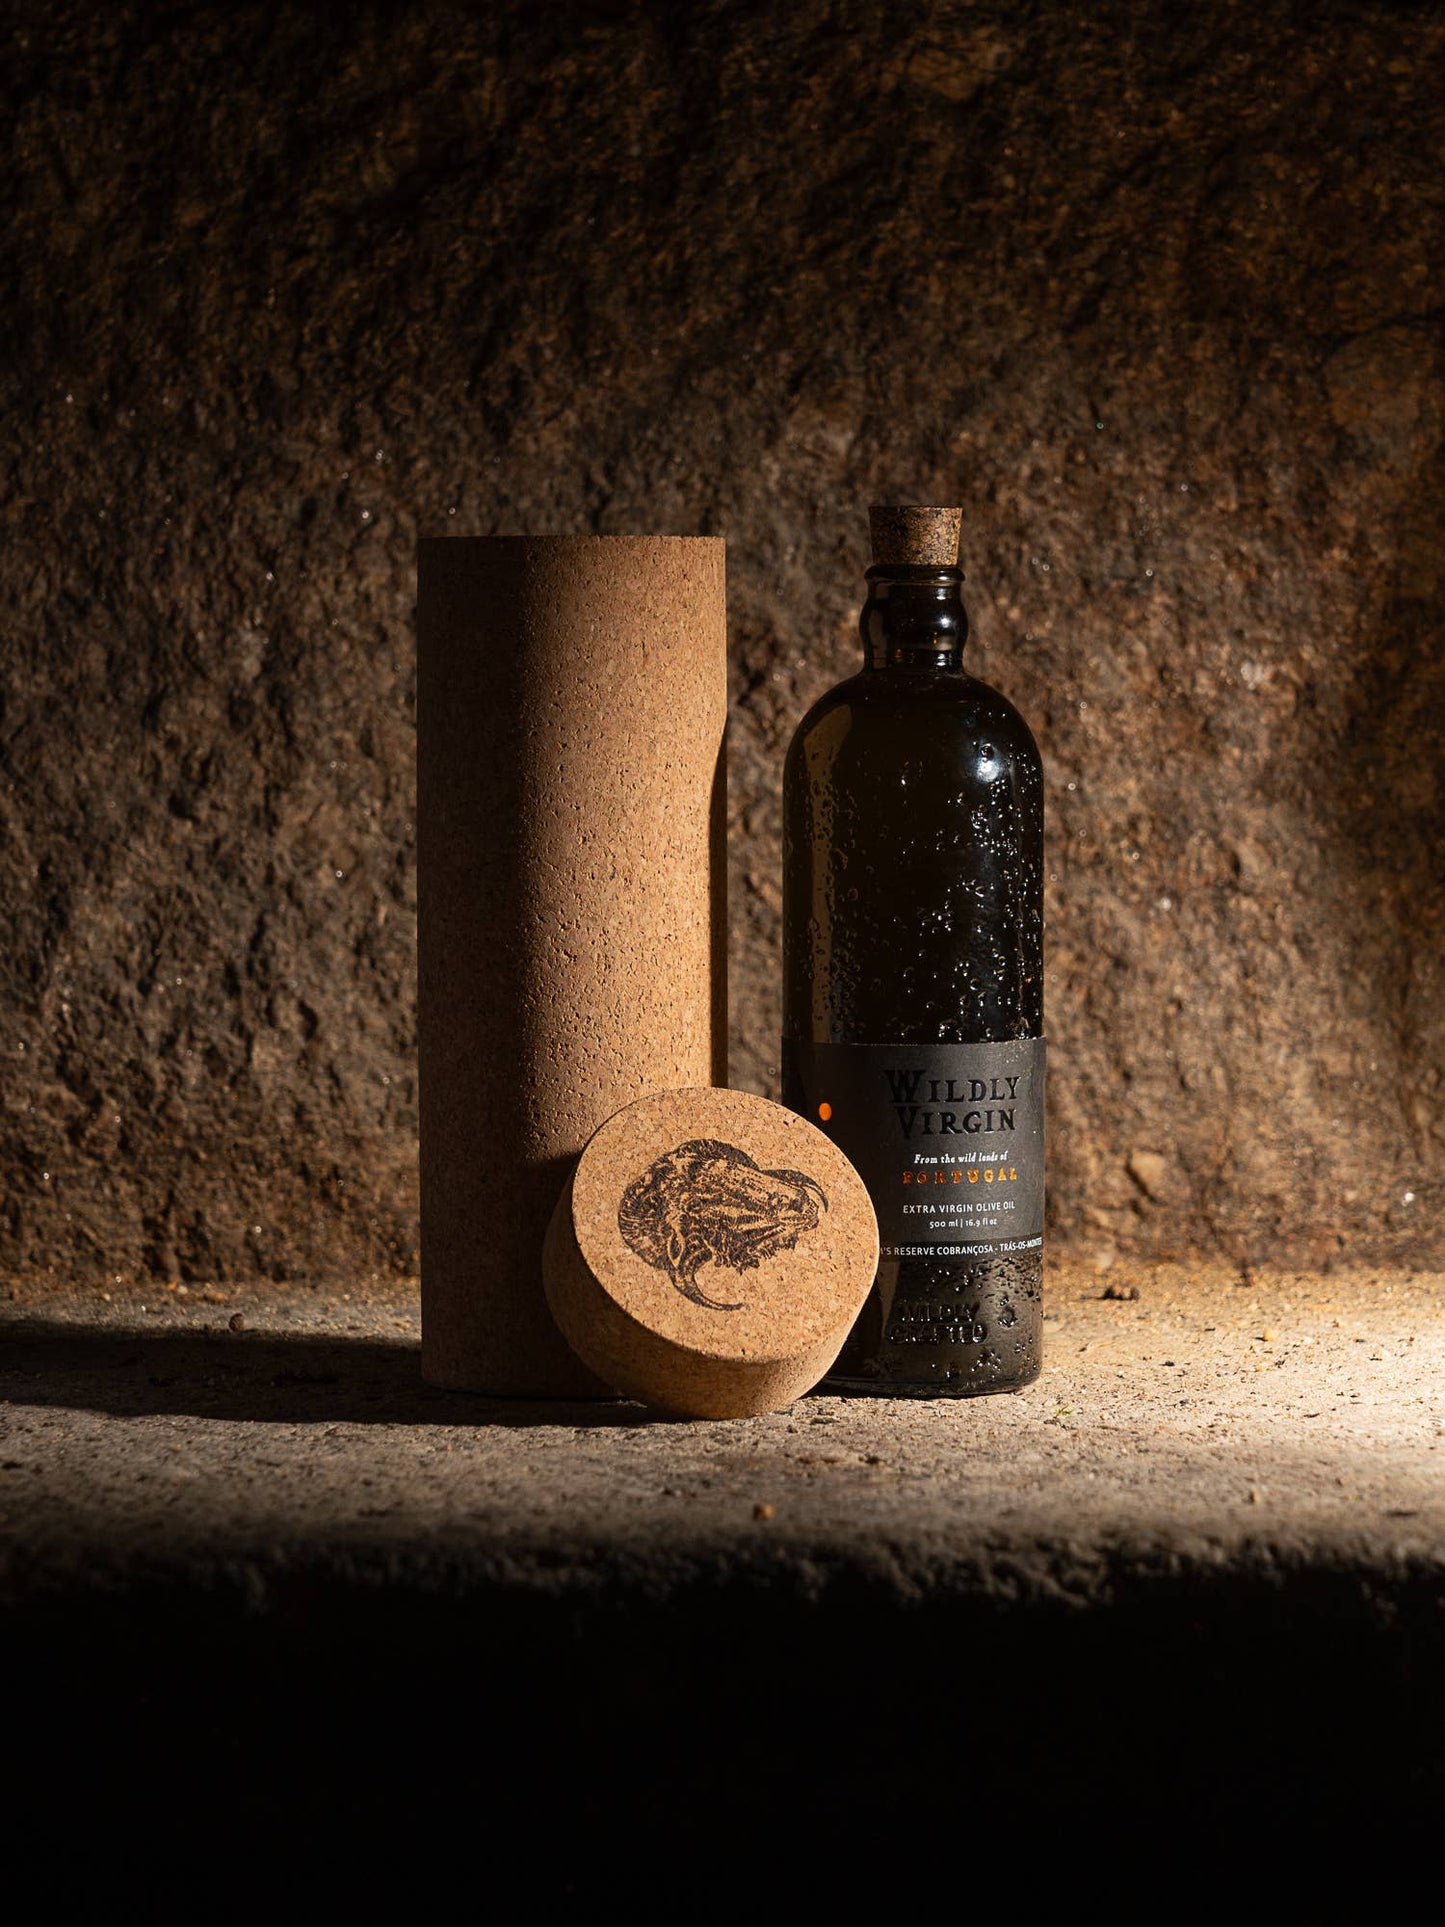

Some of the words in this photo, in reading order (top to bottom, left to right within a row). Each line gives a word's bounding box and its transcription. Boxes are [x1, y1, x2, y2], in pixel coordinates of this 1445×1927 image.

[914, 1154, 938, 1164] From
[941, 1153, 956, 1164] the
[958, 1152, 977, 1163] wild
[1000, 1150, 1009, 1161] of
[902, 1167, 1017, 1184] PORTUGAL
[903, 1205, 936, 1214] EXTRA
[939, 1204, 973, 1213] VIRGIN
[976, 1202, 1001, 1212] OLIVE
[1003, 1201, 1015, 1210] OIL
[929, 1221, 946, 1229] 500
[948, 1219, 959, 1228] ml
[965, 1219, 981, 1228] 16.9
[982, 1218, 989, 1226] fl
[989, 1218, 997, 1226] oz
[894, 1246, 935, 1256] RESERVE
[936, 1244, 994, 1256] COBRANÇOSA
